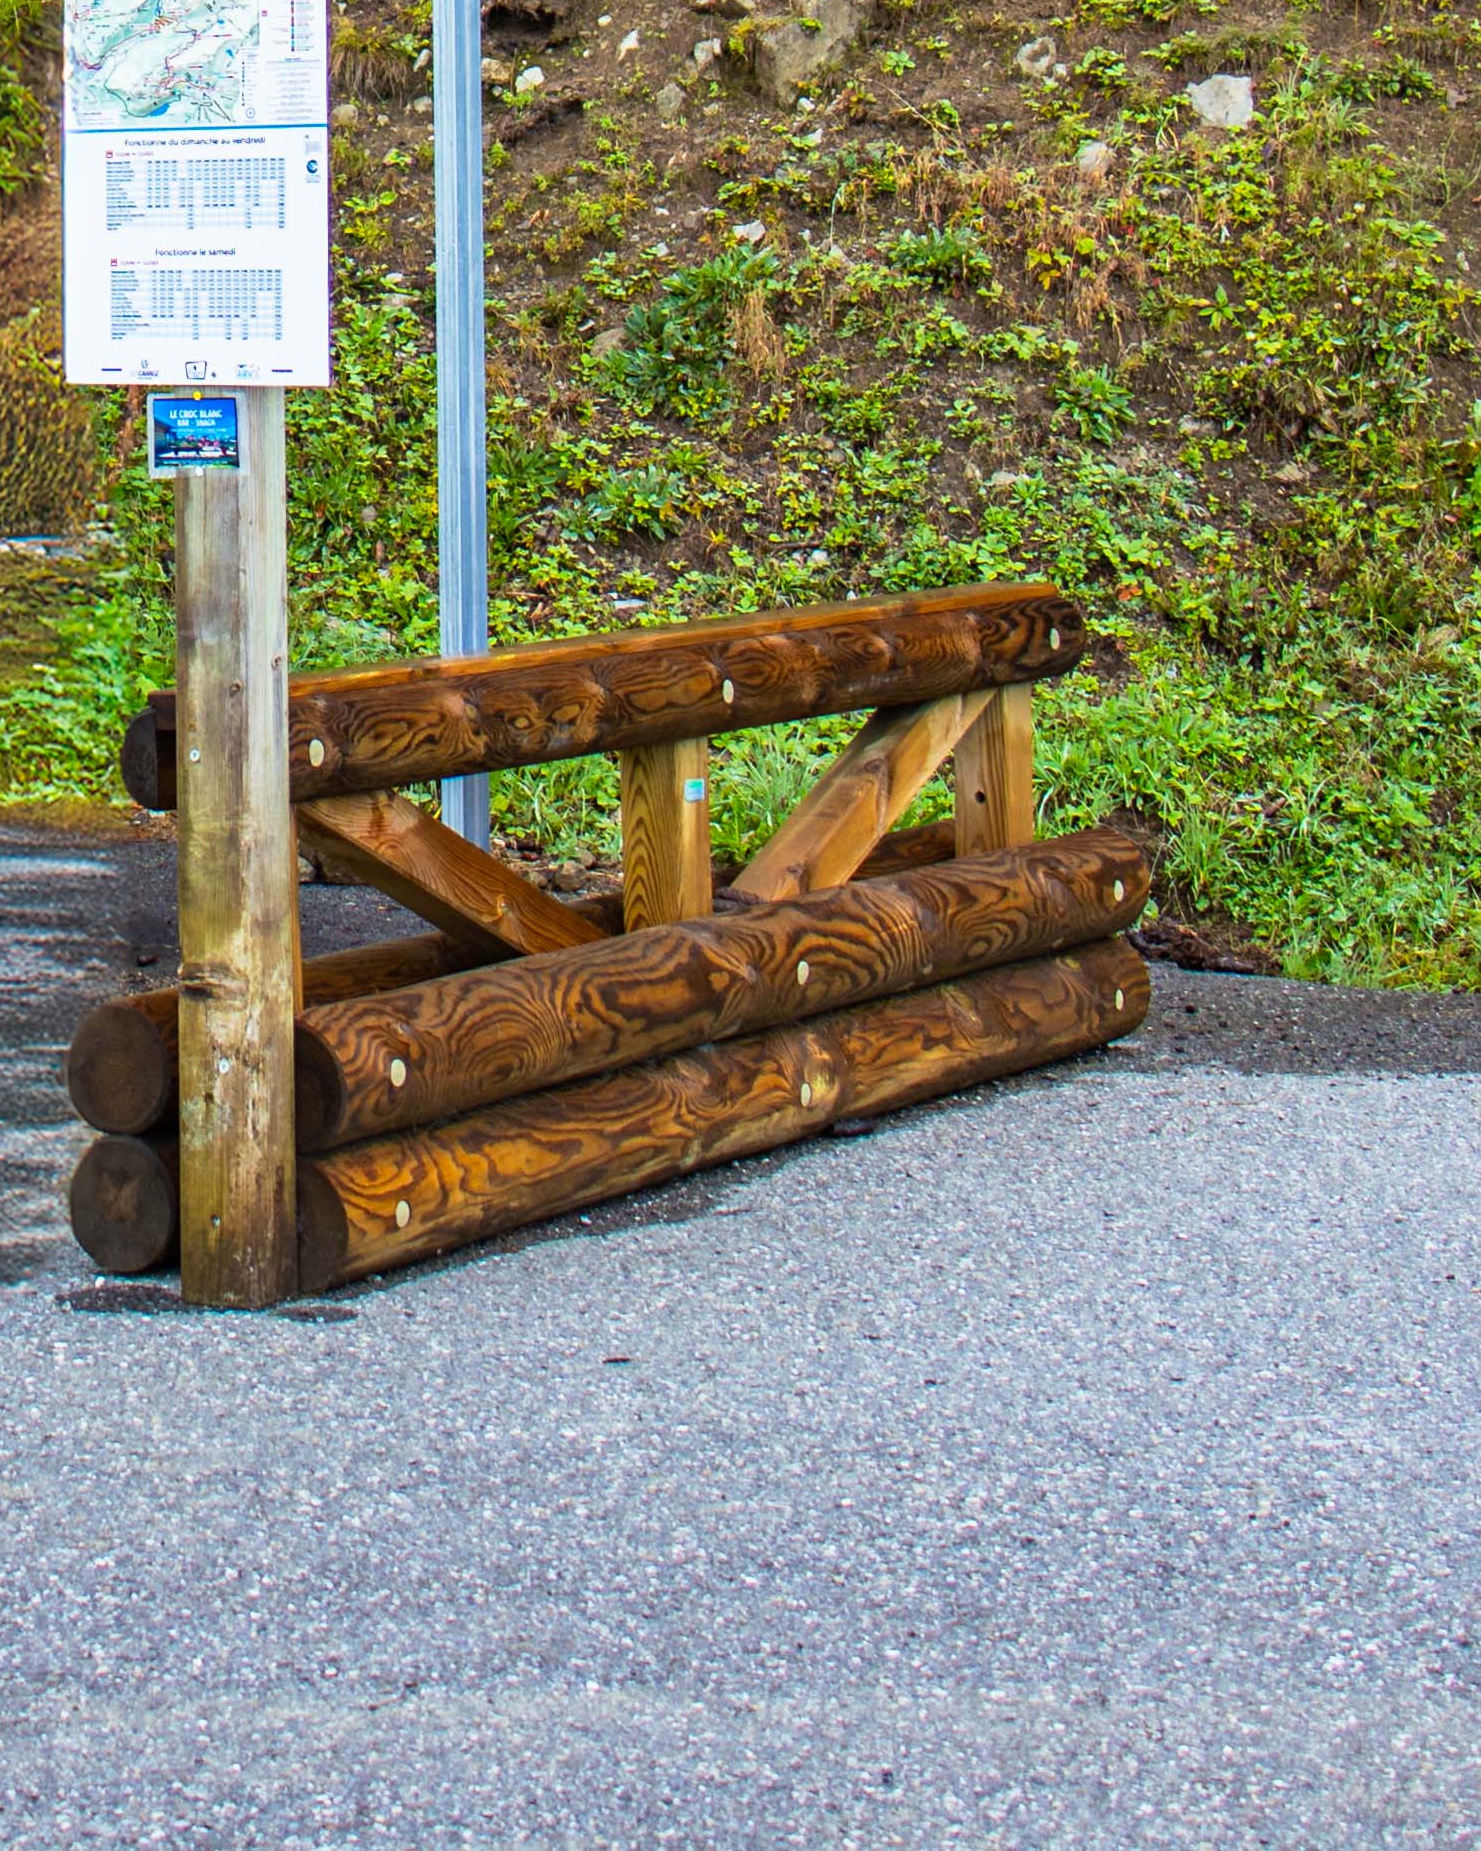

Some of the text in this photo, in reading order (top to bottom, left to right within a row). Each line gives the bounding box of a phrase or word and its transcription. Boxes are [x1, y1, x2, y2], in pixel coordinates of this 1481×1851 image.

[181, 138, 219, 146] dimanche
[232, 137, 266, 145] vendredi
[208, 248, 236, 256] samedi
[169, 409, 178, 419] LE
